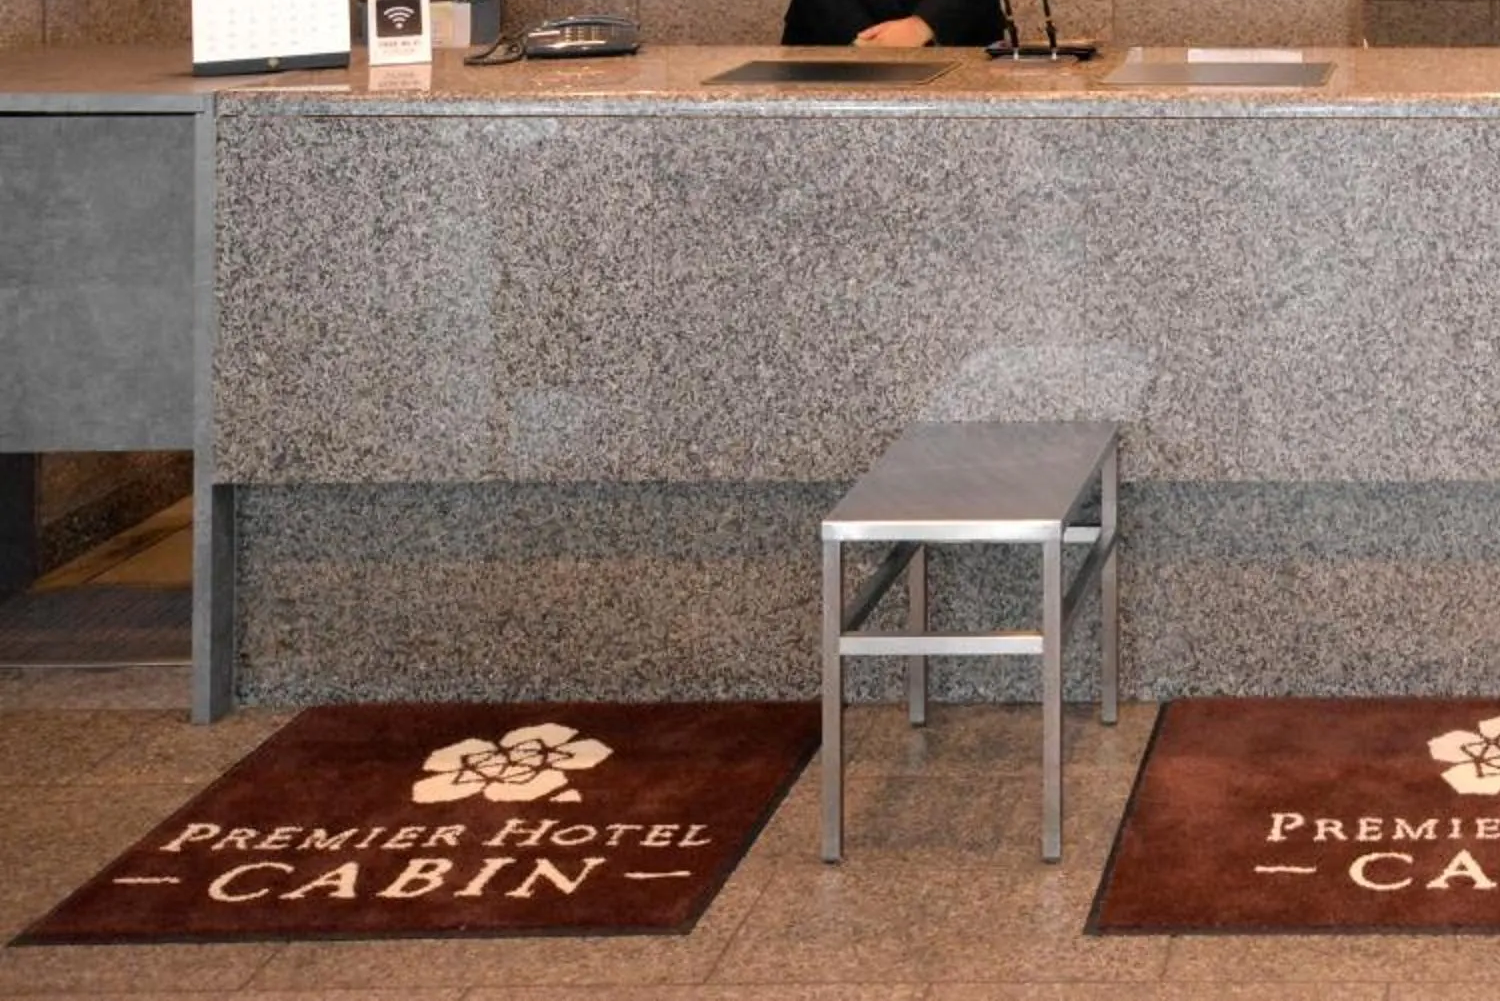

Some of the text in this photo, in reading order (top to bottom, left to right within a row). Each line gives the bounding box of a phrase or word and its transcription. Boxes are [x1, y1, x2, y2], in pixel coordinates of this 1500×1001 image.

[160, 818, 711, 853] PREMIER HOTEL
[208, 857, 607, 902] CABIN
